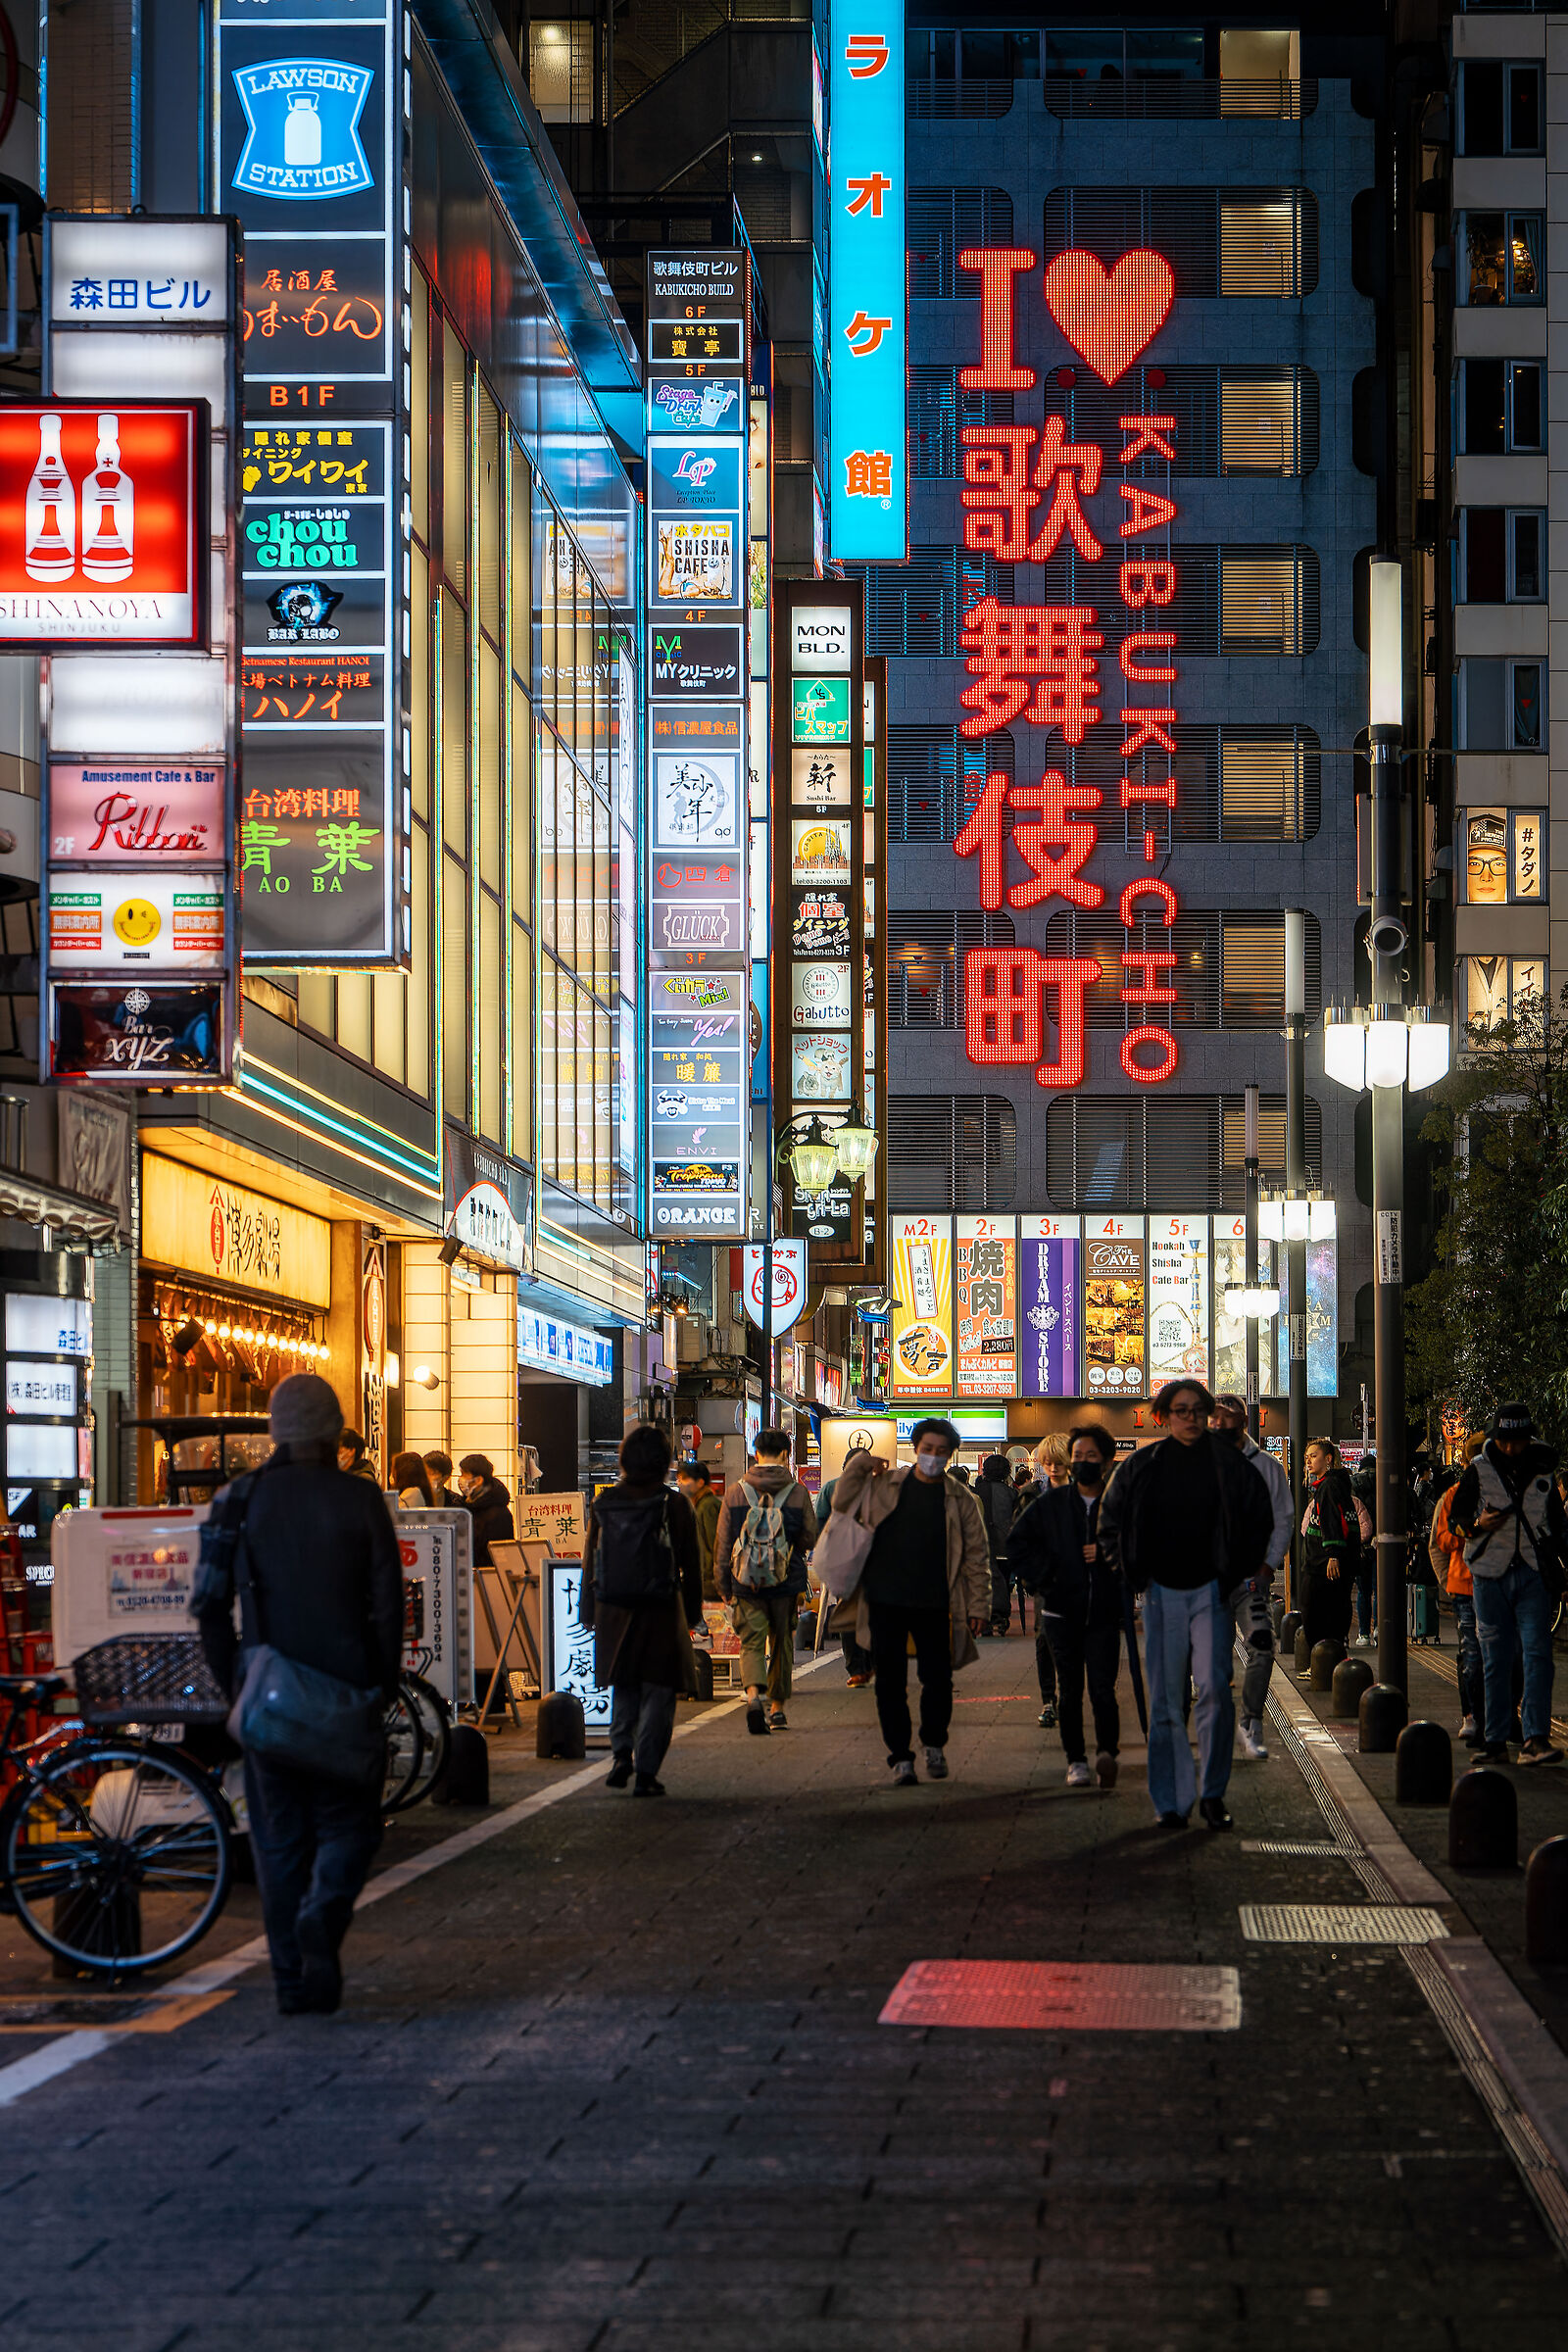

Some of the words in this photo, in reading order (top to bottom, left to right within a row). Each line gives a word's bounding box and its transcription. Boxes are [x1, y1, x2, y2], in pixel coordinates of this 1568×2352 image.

[248, 68, 360, 95] LAWSON
[249, 162, 360, 188] STATION
[653, 261, 738, 276] 歌舞伎町ビル
[261, 270, 338, 292] 居酒屋
[655, 284, 707, 296] KABUKICHO
[709, 284, 734, 296] BUILD
[70, 277, 211, 310] 森田ビル
[685, 305, 707, 318] 6F
[959, 249, 1036, 390] I
[673, 326, 718, 336] 株式会社
[685, 365, 707, 376] 5F
[270, 385, 335, 407] B1F
[658, 398, 704, 414] Drink
[268, 460, 369, 485] ワイワイ
[246, 513, 349, 544] chou
[674, 523, 729, 538] 水タバコ
[257, 541, 359, 567] chou
[674, 558, 709, 573] CAFE
[685, 611, 707, 622] 4F
[37, 622, 122, 634] SHINJUKU
[797, 625, 846, 636] MON
[798, 642, 846, 654] BLD.
[288, 656, 336, 666] Restaurant
[337, 656, 370, 666] HANOI
[655, 662, 737, 680] MYクリニック
[252, 690, 343, 720] ハノイ
[953, 415, 1105, 1088] 歌舞伎町
[1118, 416, 1177, 1083] KABUKI-CHO
[81, 770, 152, 783] Amusement
[155, 770, 182, 783] Cafe
[183, 771, 193, 783] &
[195, 771, 216, 783] Bar
[806, 762, 837, 794] 新
[244, 788, 362, 818] 台湾料理
[54, 836, 75, 856] 2F
[798, 902, 846, 918] 個室
[792, 916, 851, 931] ダイニング
[685, 952, 707, 964] 3F
[835, 945, 851, 956] 3F
[837, 964, 851, 974] 2F
[698, 986, 730, 1008] Mix!
[794, 1005, 850, 1023] Gabutto
[676, 1147, 717, 1155] ENVI
[657, 1207, 736, 1224] ORANGE
[904, 1218, 938, 1236] M2F
[976, 1218, 997, 1236] 2F
[1039, 1218, 1059, 1236] 3F
[1102, 1218, 1124, 1236] 4F
[1169, 1218, 1190, 1236] 5F
[1152, 1241, 1186, 1251] Hookah
[1152, 1258, 1183, 1268] Shisha
[968, 1240, 1005, 1317] 焼肉
[1037, 1242, 1051, 1304] DREAM
[1152, 1275, 1172, 1285] Cafe
[1173, 1275, 1190, 1285] Bar
[1037, 1331, 1051, 1394] STORE
[1089, 1386, 1141, 1395] 03-3203-9020
[527, 1503, 573, 1516] 台湾料理
[520, 1516, 581, 1539] 青葉
